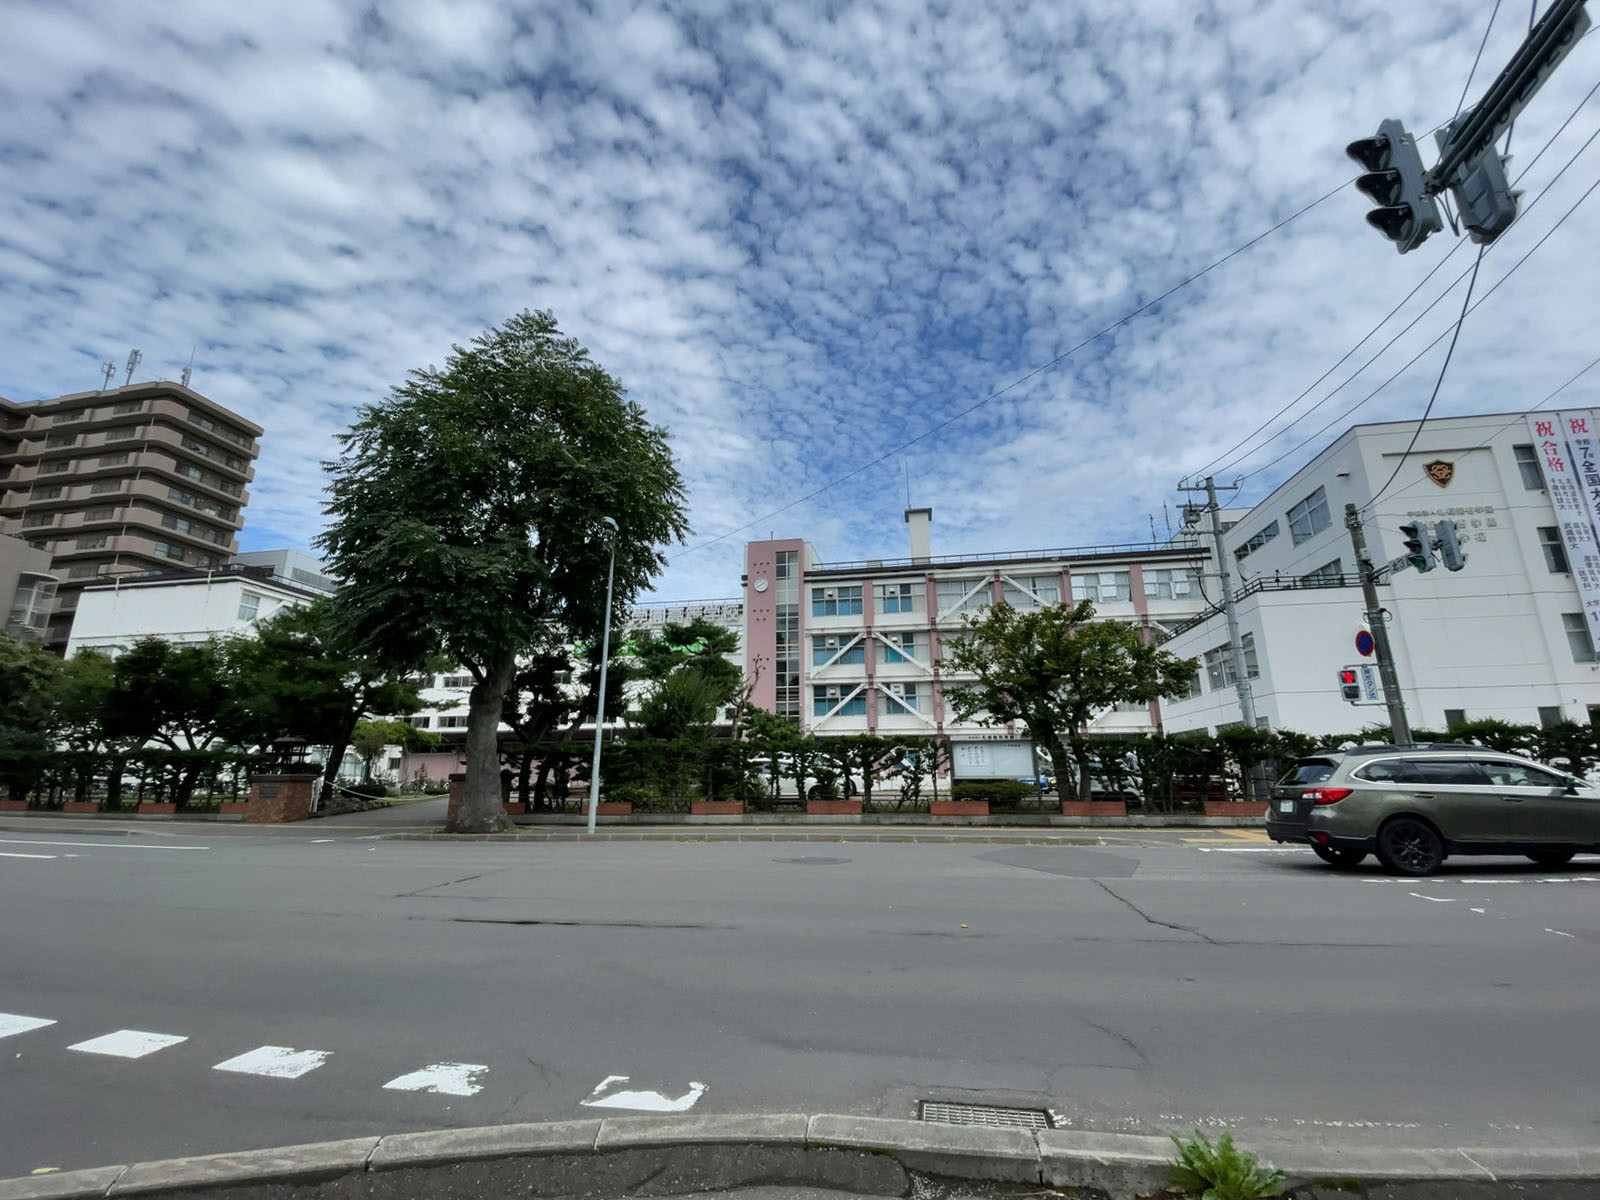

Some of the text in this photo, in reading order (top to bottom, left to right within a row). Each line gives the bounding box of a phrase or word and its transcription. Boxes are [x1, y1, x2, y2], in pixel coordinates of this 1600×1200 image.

[1569, 418, 1589, 434] 祝
[1535, 421, 1564, 472] 祝合格
